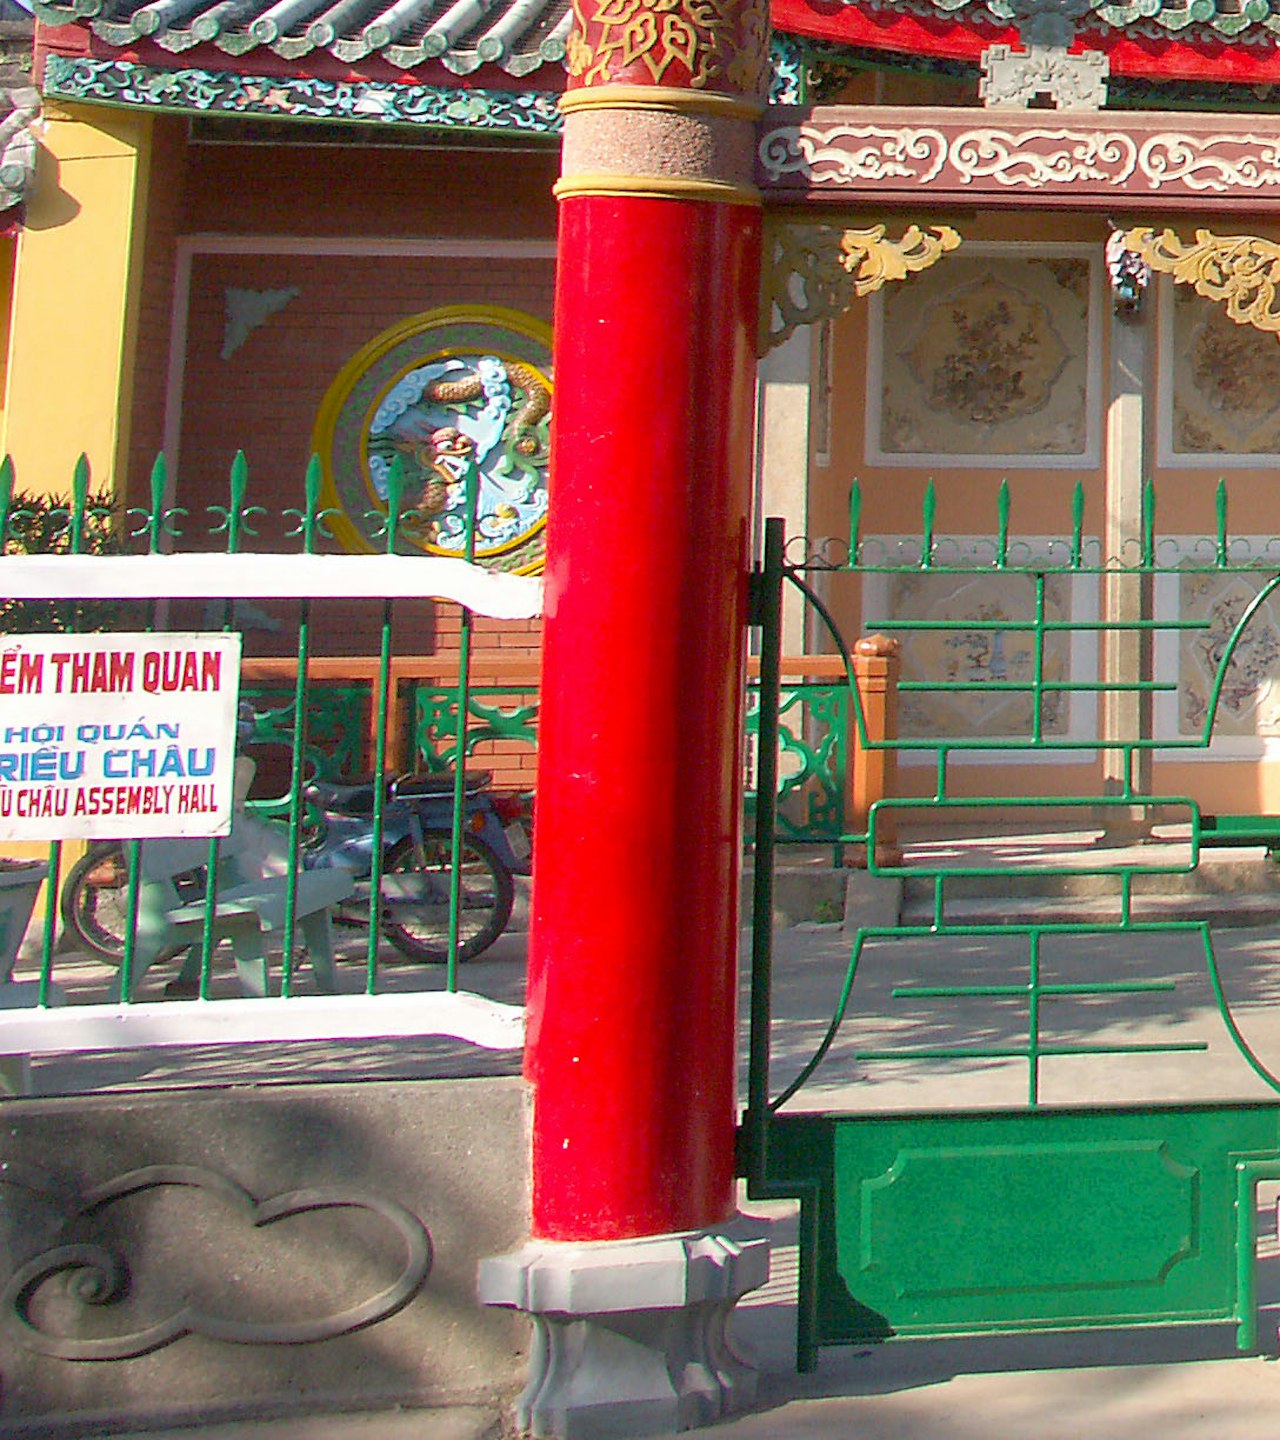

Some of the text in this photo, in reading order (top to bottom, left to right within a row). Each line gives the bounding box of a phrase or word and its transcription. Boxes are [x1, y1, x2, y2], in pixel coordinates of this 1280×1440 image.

[51, 651, 136, 694] THAM
[142, 651, 223, 696] QUAN
[4, 715, 181, 745] HỘI QUÁN
[102, 745, 217, 779] CHÂU
[17, 785, 70, 818] CHÂU
[73, 784, 175, 817] ASSEMBLY
[178, 783, 219, 815] HALL
